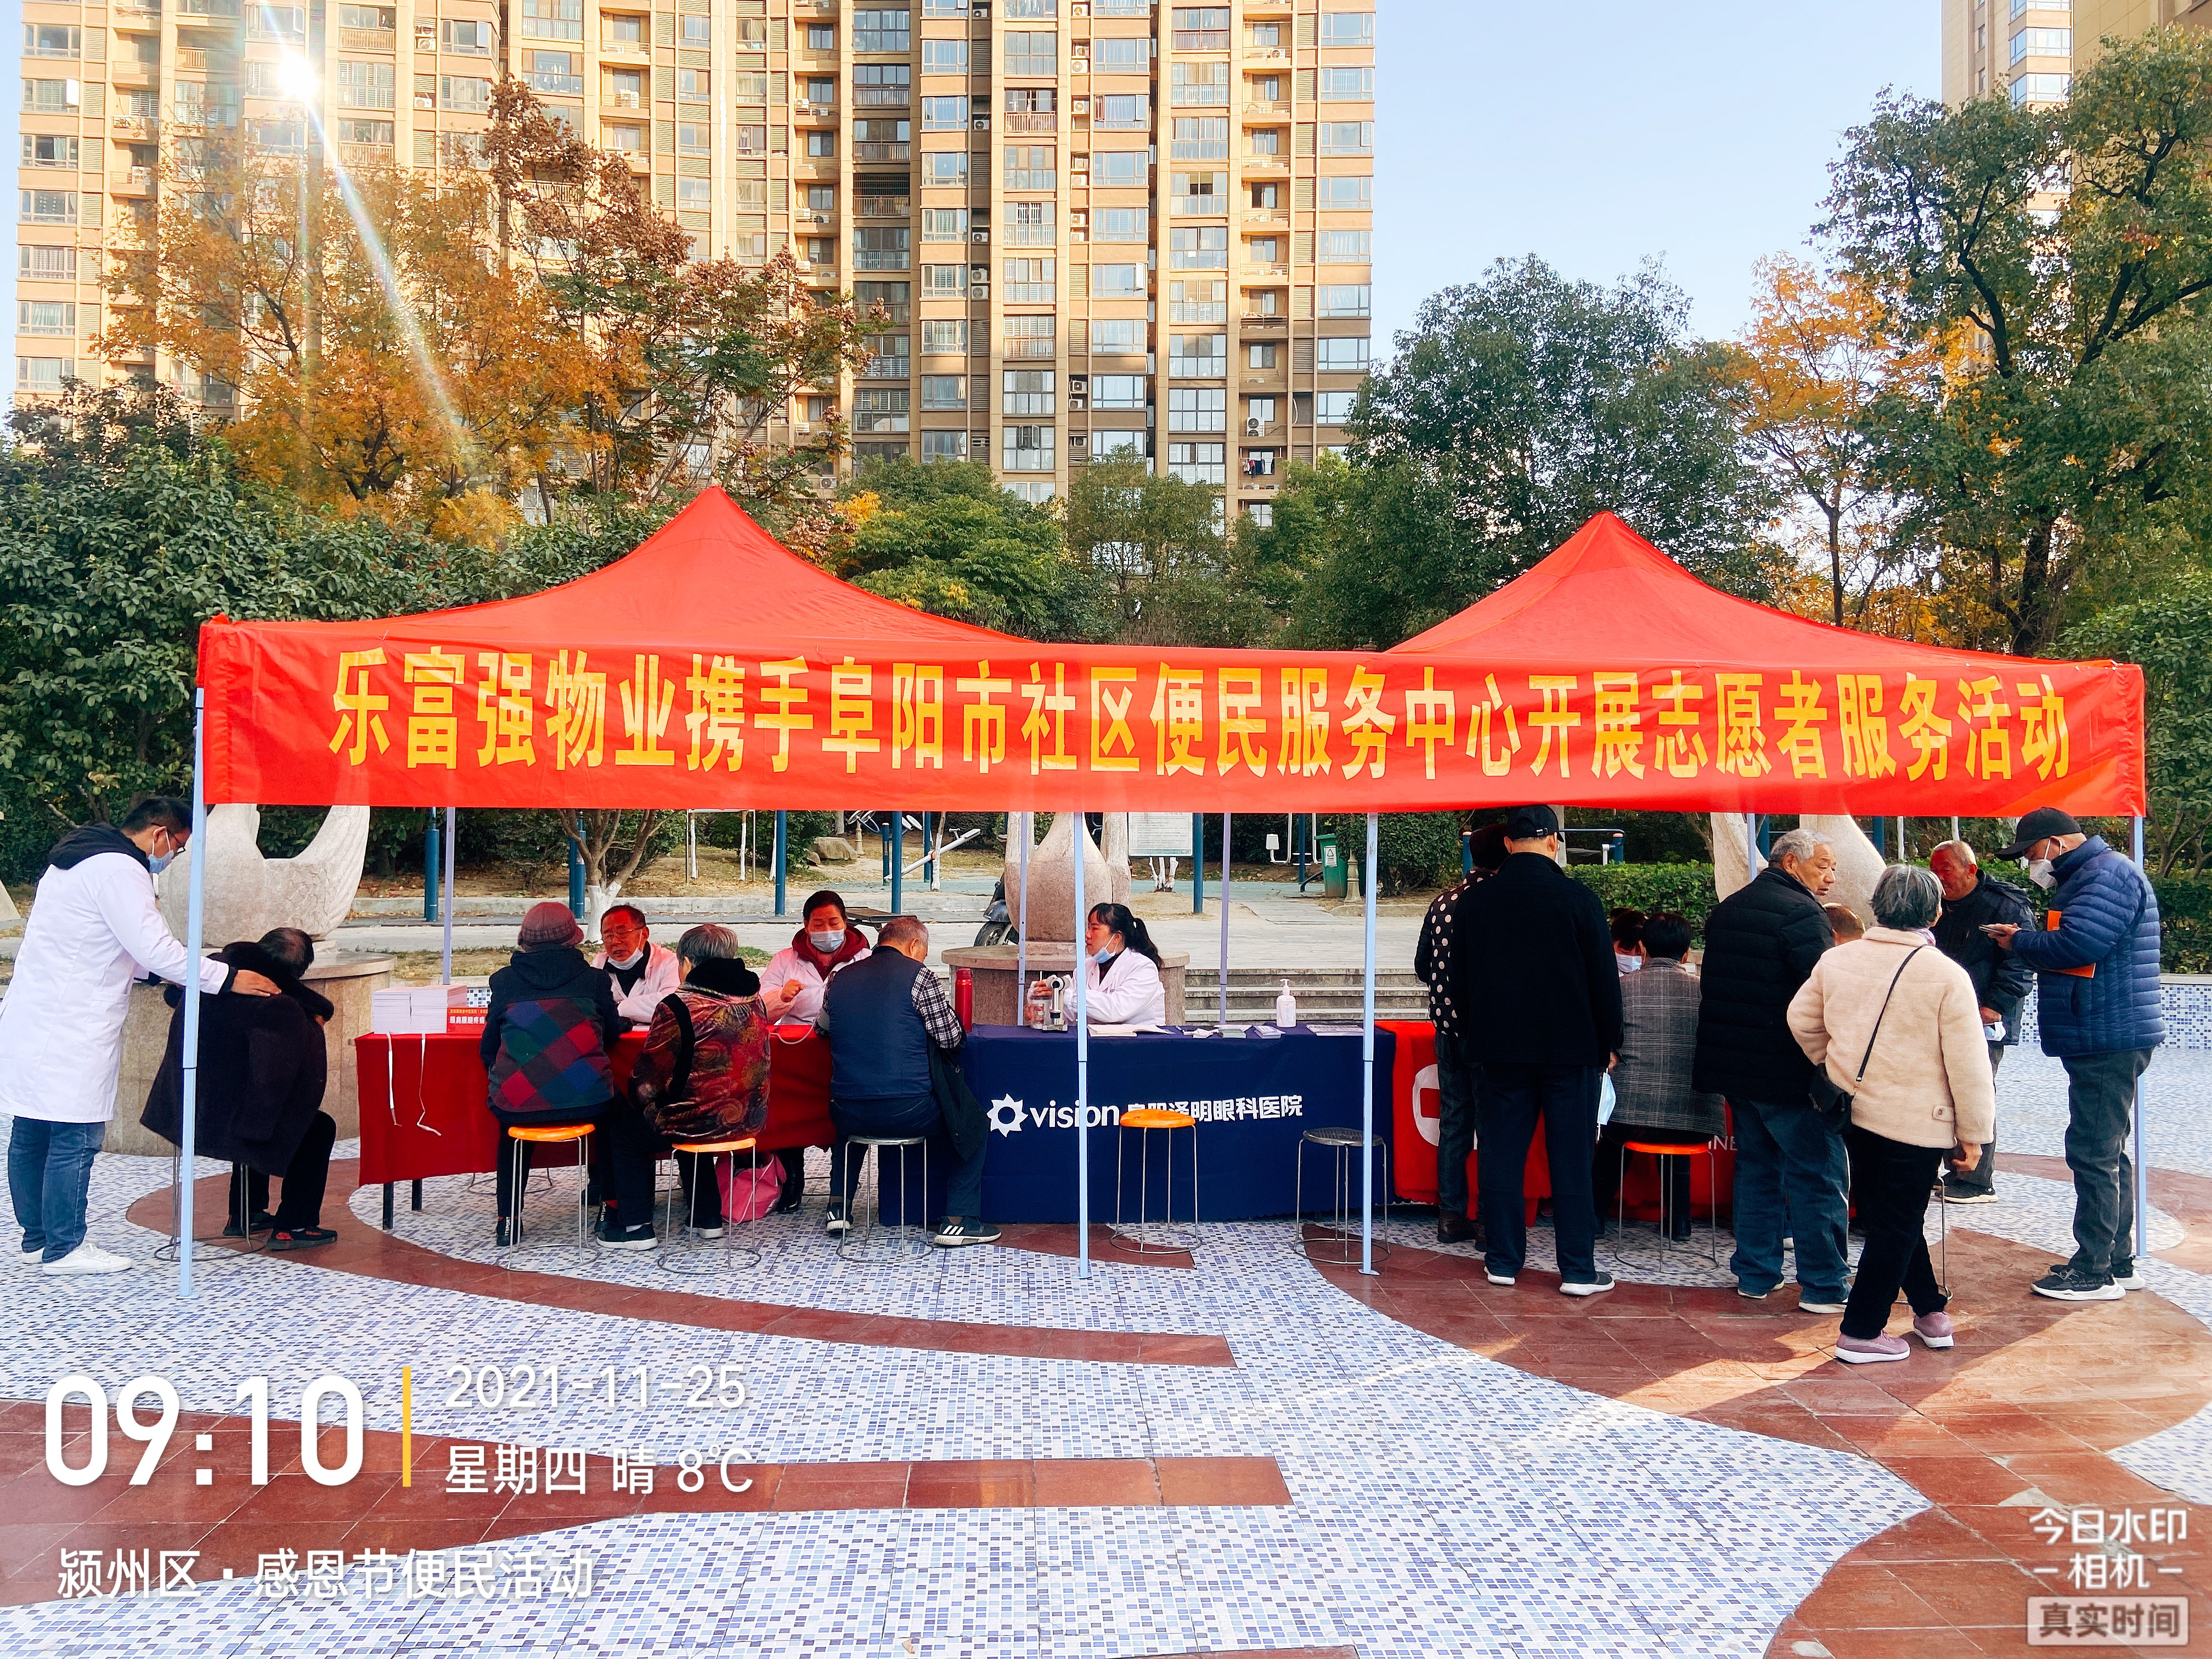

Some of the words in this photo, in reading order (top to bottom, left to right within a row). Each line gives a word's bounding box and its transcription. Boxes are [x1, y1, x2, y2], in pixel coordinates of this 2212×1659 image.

[329, 646, 2069, 781] 乐富强物业携手阜阳市社区便民服务中心开展志愿者服务活动
[1030, 1100, 1120, 1128] vision
